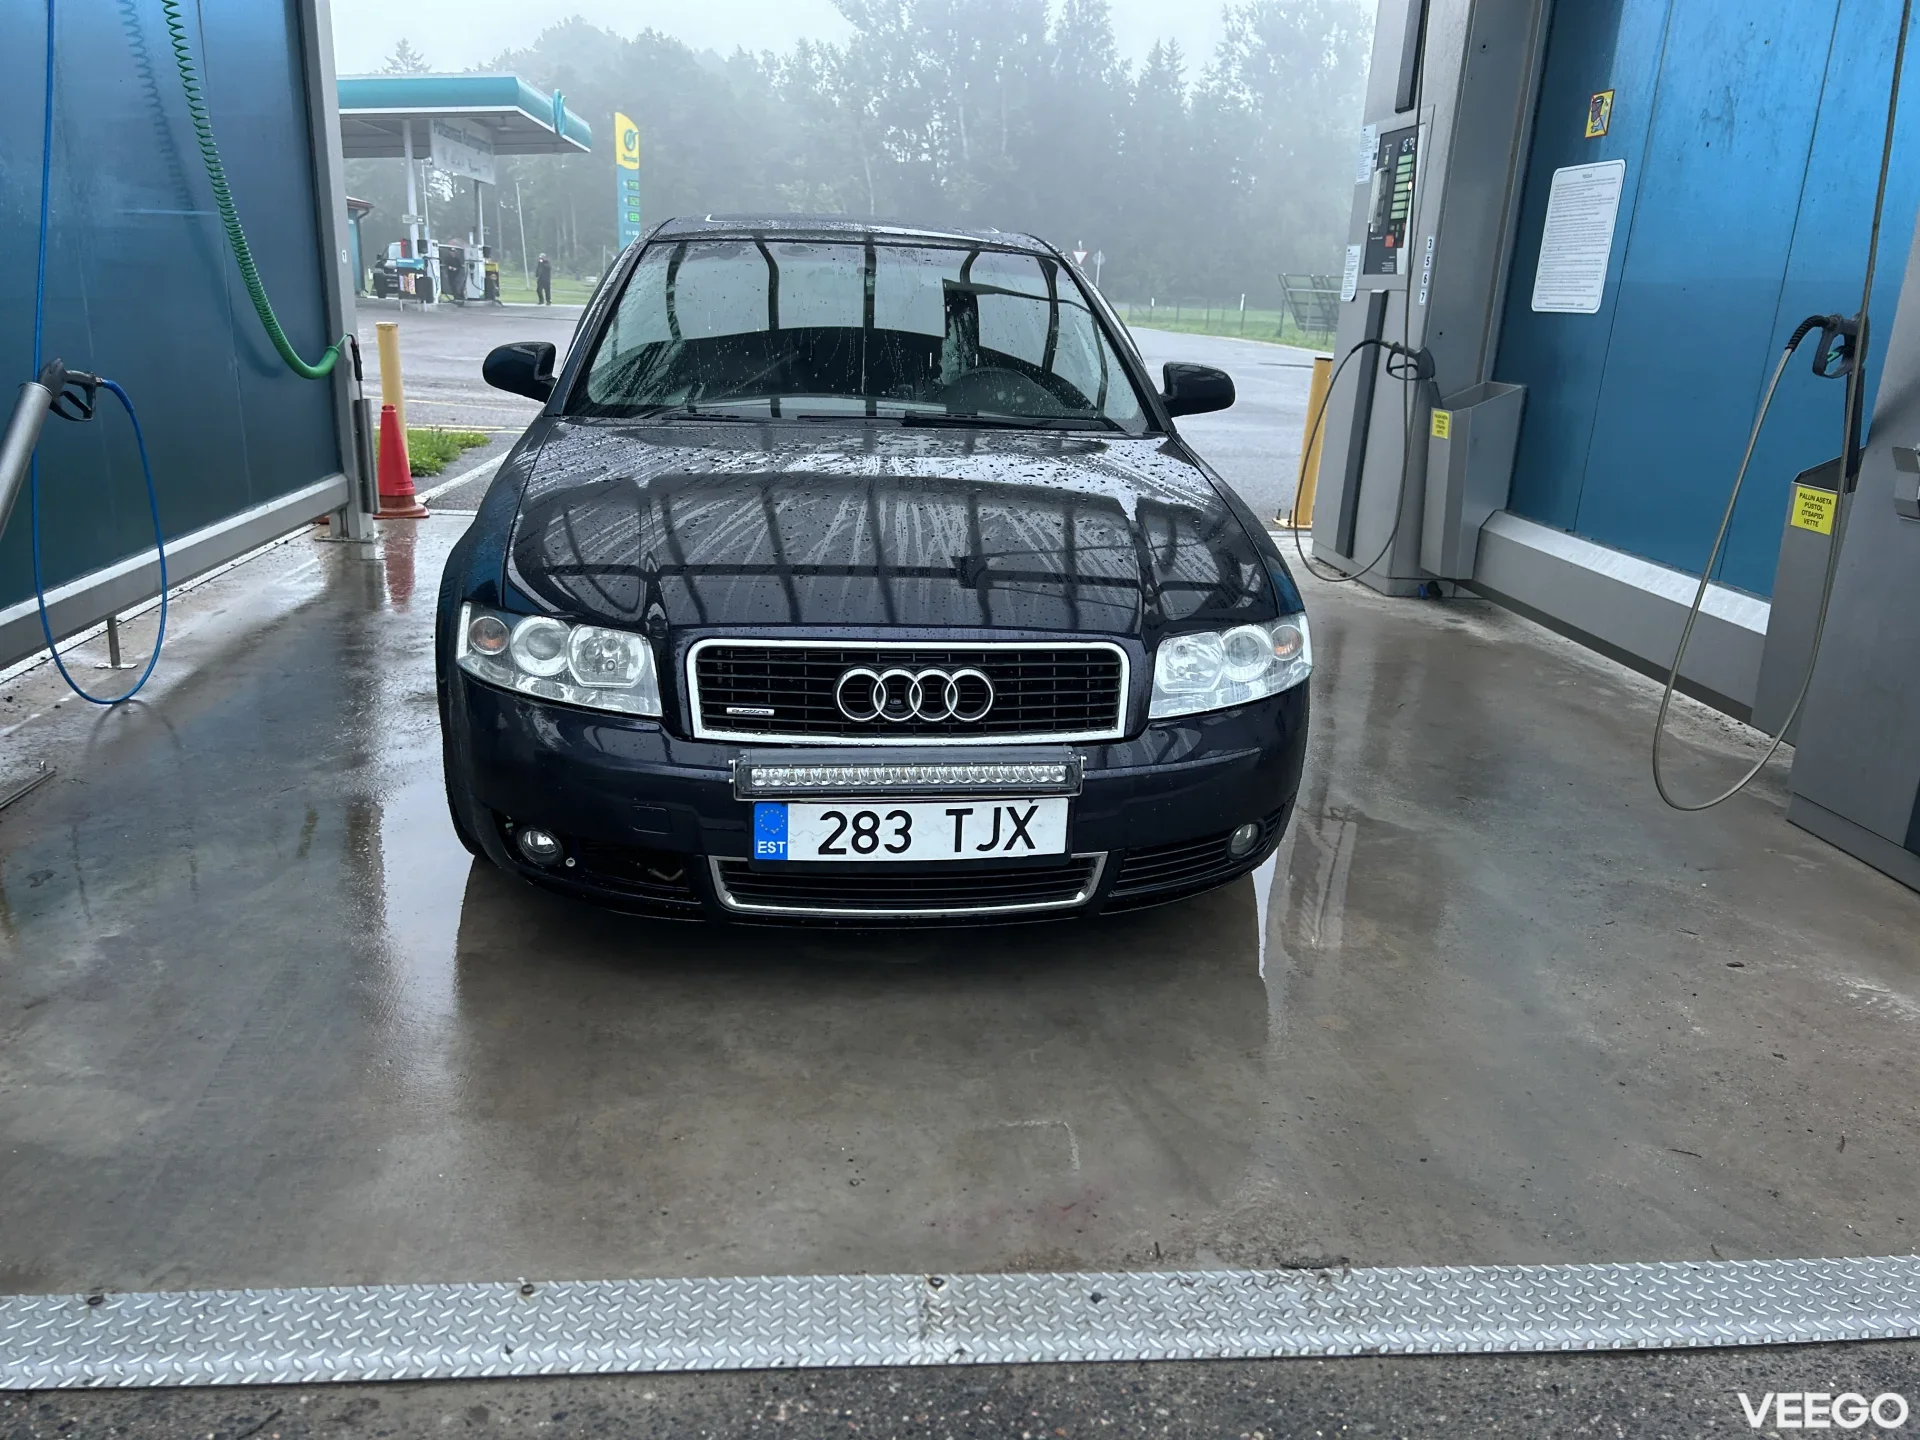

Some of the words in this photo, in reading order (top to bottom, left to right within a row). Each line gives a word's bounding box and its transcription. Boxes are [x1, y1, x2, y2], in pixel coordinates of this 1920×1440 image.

[1428, 238, 1433, 249] 3
[1425, 256, 1430, 266] 5
[1423, 274, 1428, 284] 6
[1420, 292, 1425, 301] 7
[1799, 492, 1816, 501] PALUN
[1816, 496, 1832, 505] ASETA
[1804, 502, 1824, 512] PÜSTOL
[1801, 510, 1824, 520] OTSAPIDI
[1804, 518, 1820, 527] VETTE
[817, 809, 913, 856] 283
[945, 805, 1040, 853] TJX
[757, 840, 787, 855] EST
